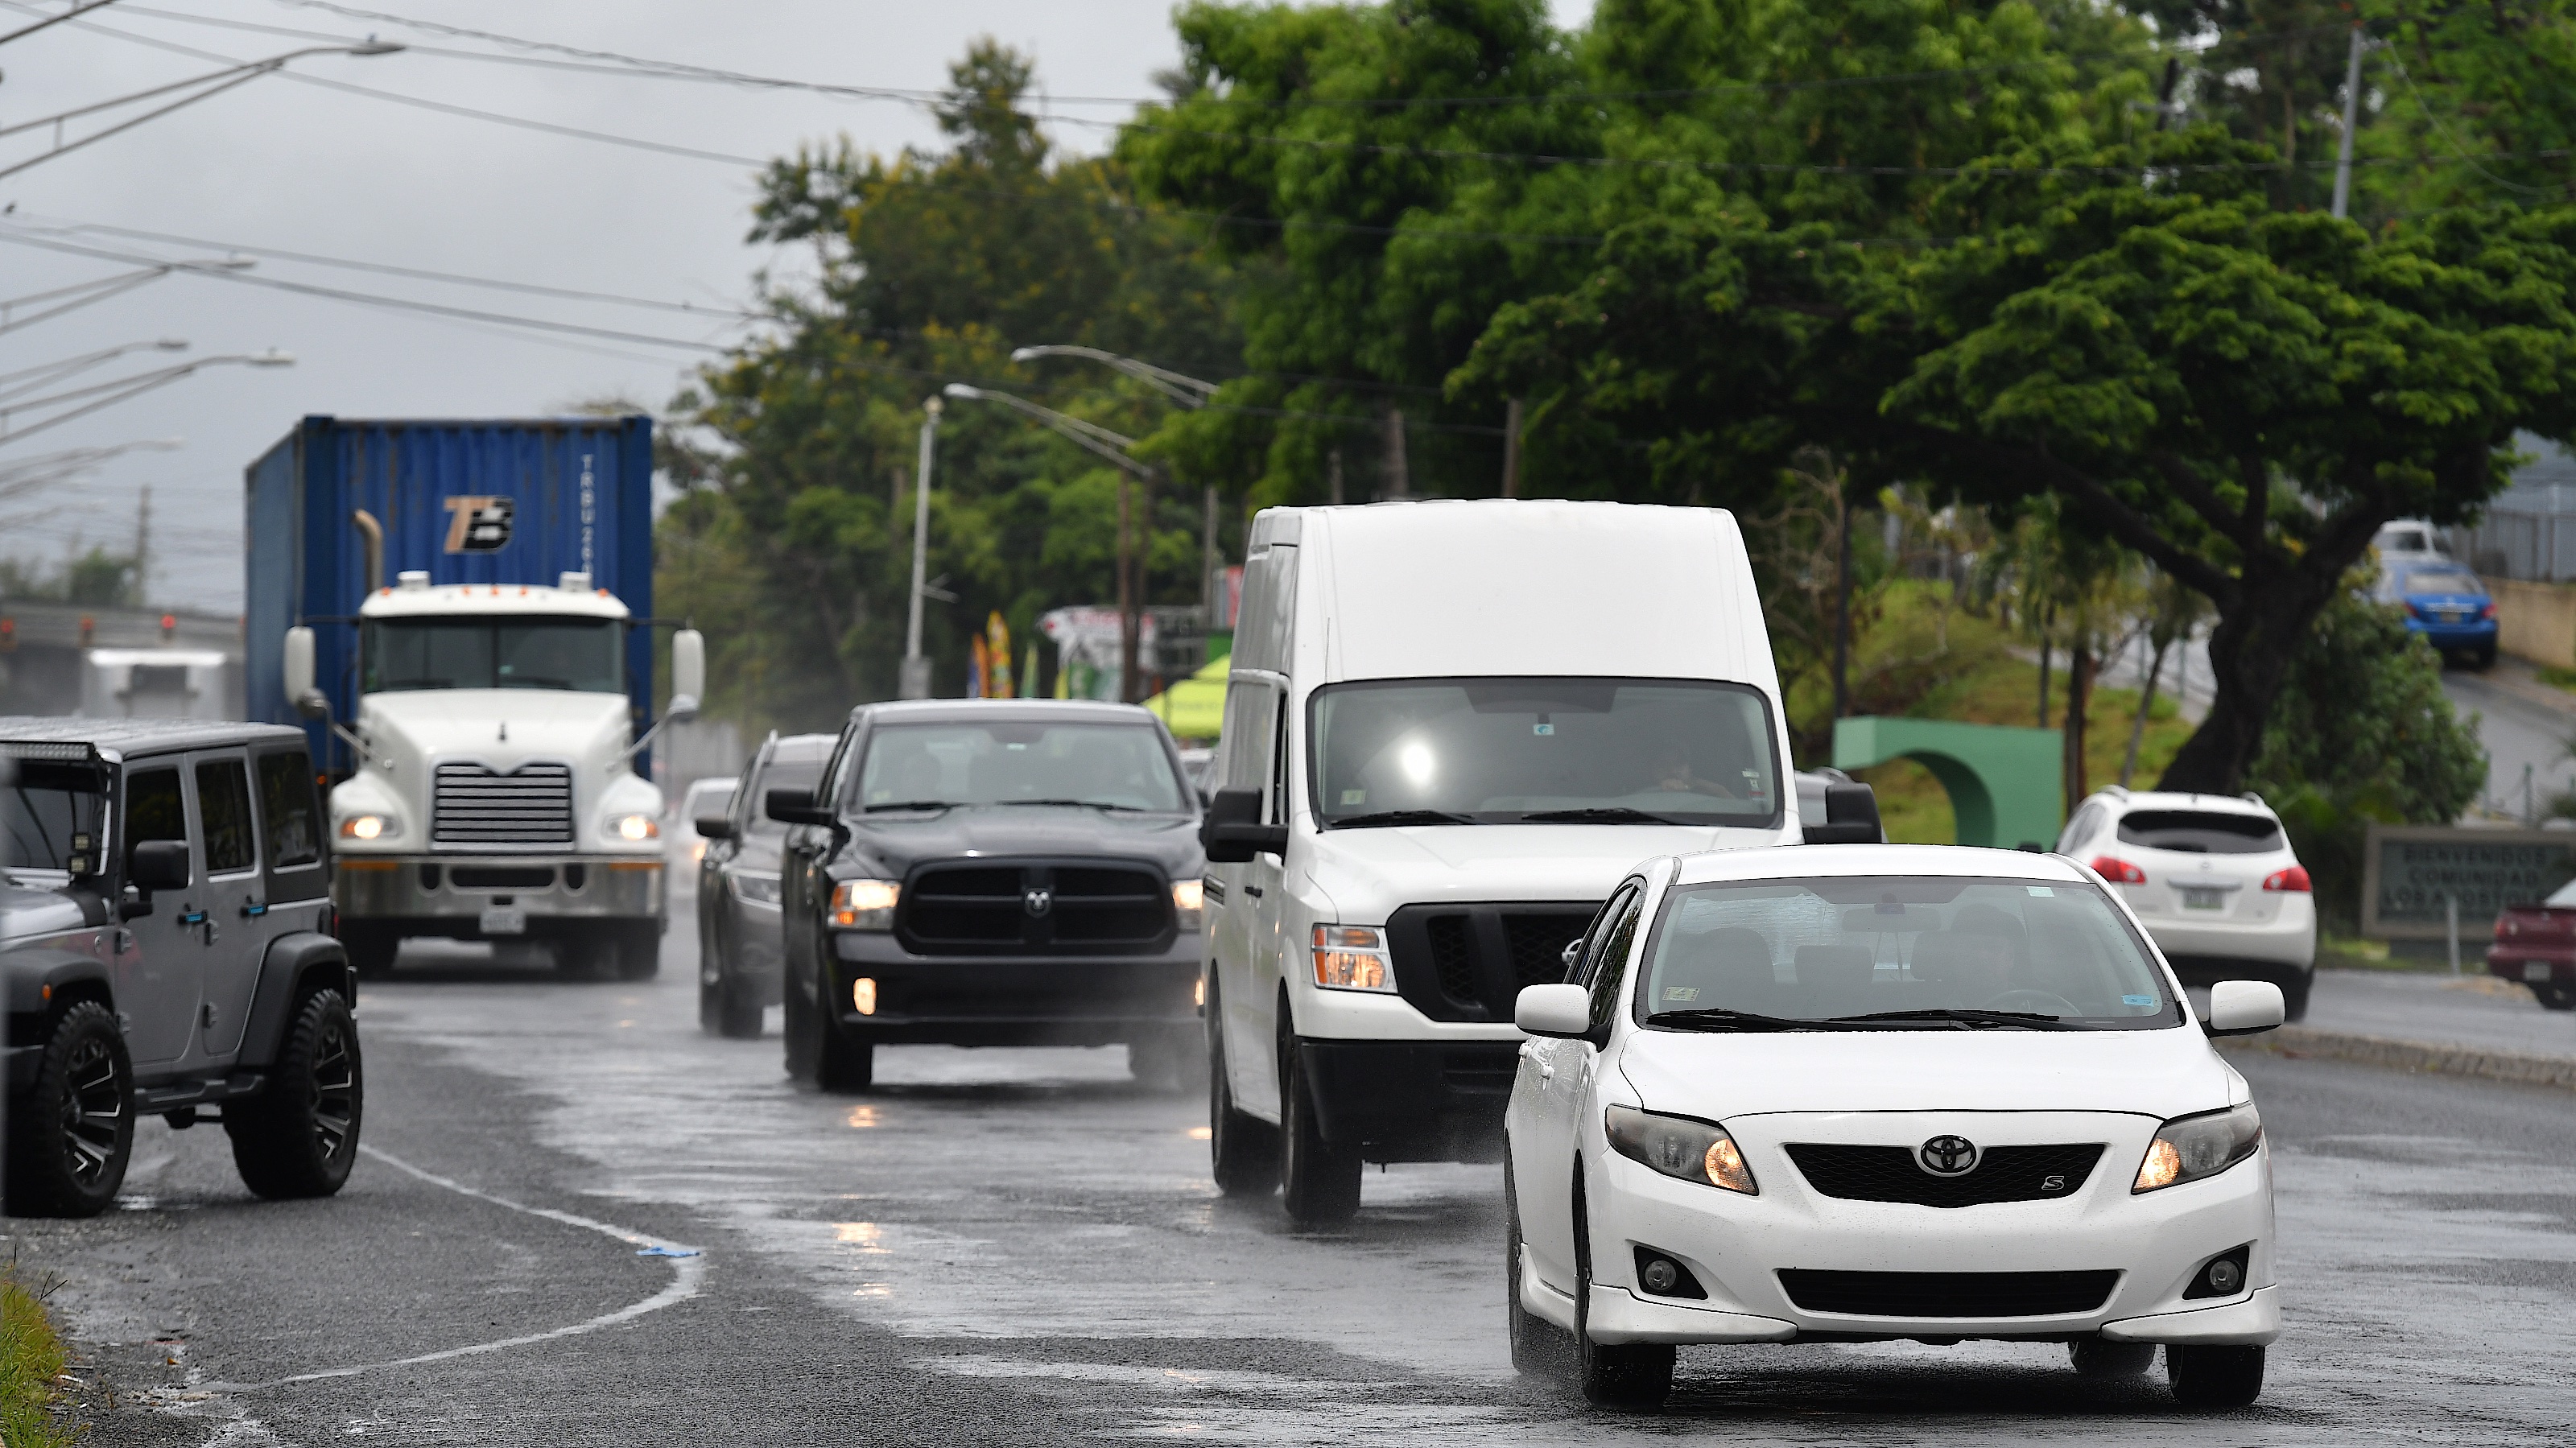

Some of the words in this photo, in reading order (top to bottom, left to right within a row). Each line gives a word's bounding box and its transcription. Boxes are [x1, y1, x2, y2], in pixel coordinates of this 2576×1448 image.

[444, 495, 514, 555] TB
[2403, 846, 2547, 868] BIENVENIDOS
[2408, 865, 2541, 888] COMUNIDAD
[2041, 1175, 2065, 1190] S
